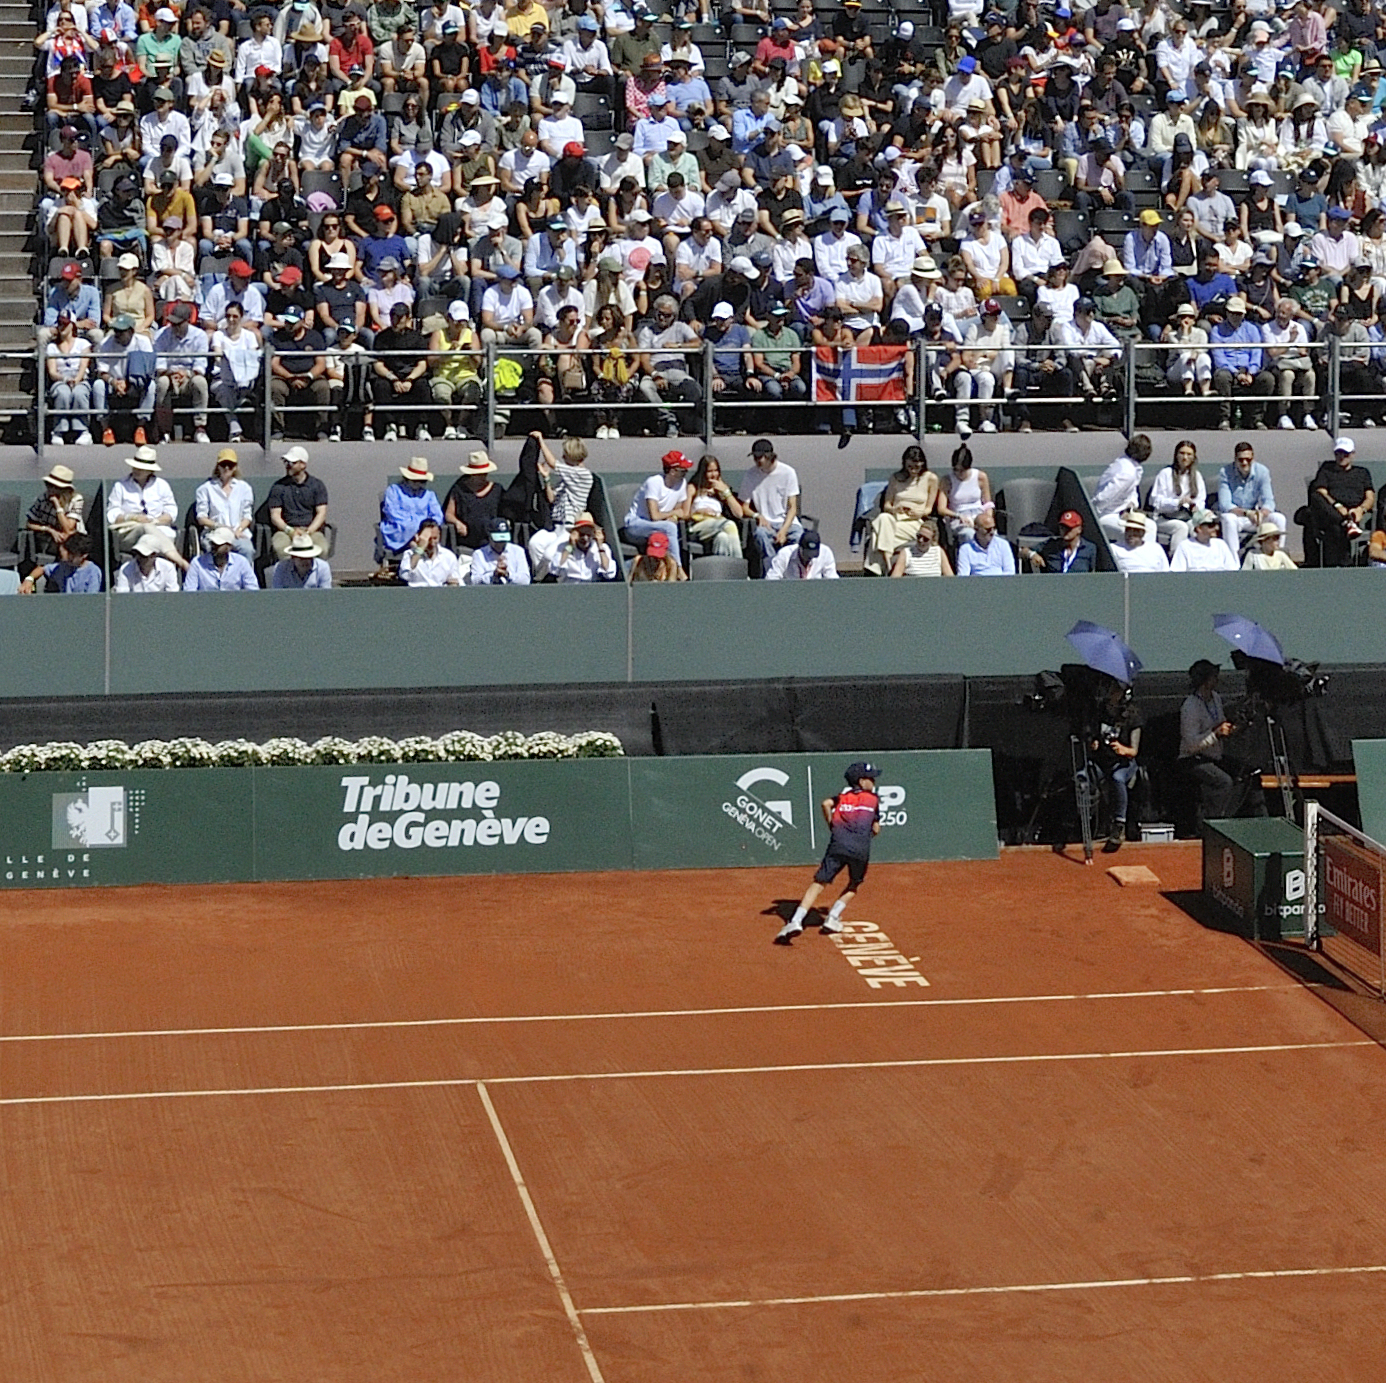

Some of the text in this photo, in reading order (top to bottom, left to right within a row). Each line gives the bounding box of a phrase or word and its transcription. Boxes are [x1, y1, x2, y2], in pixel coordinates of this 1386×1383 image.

[341, 774, 500, 812] Tribune
[736, 795, 783, 833] GONET
[879, 811, 908, 826] 250
[67, 853, 90, 863] DE
[1325, 856, 1377, 911] Emirates
[1344, 899, 1369, 934] BETTER
